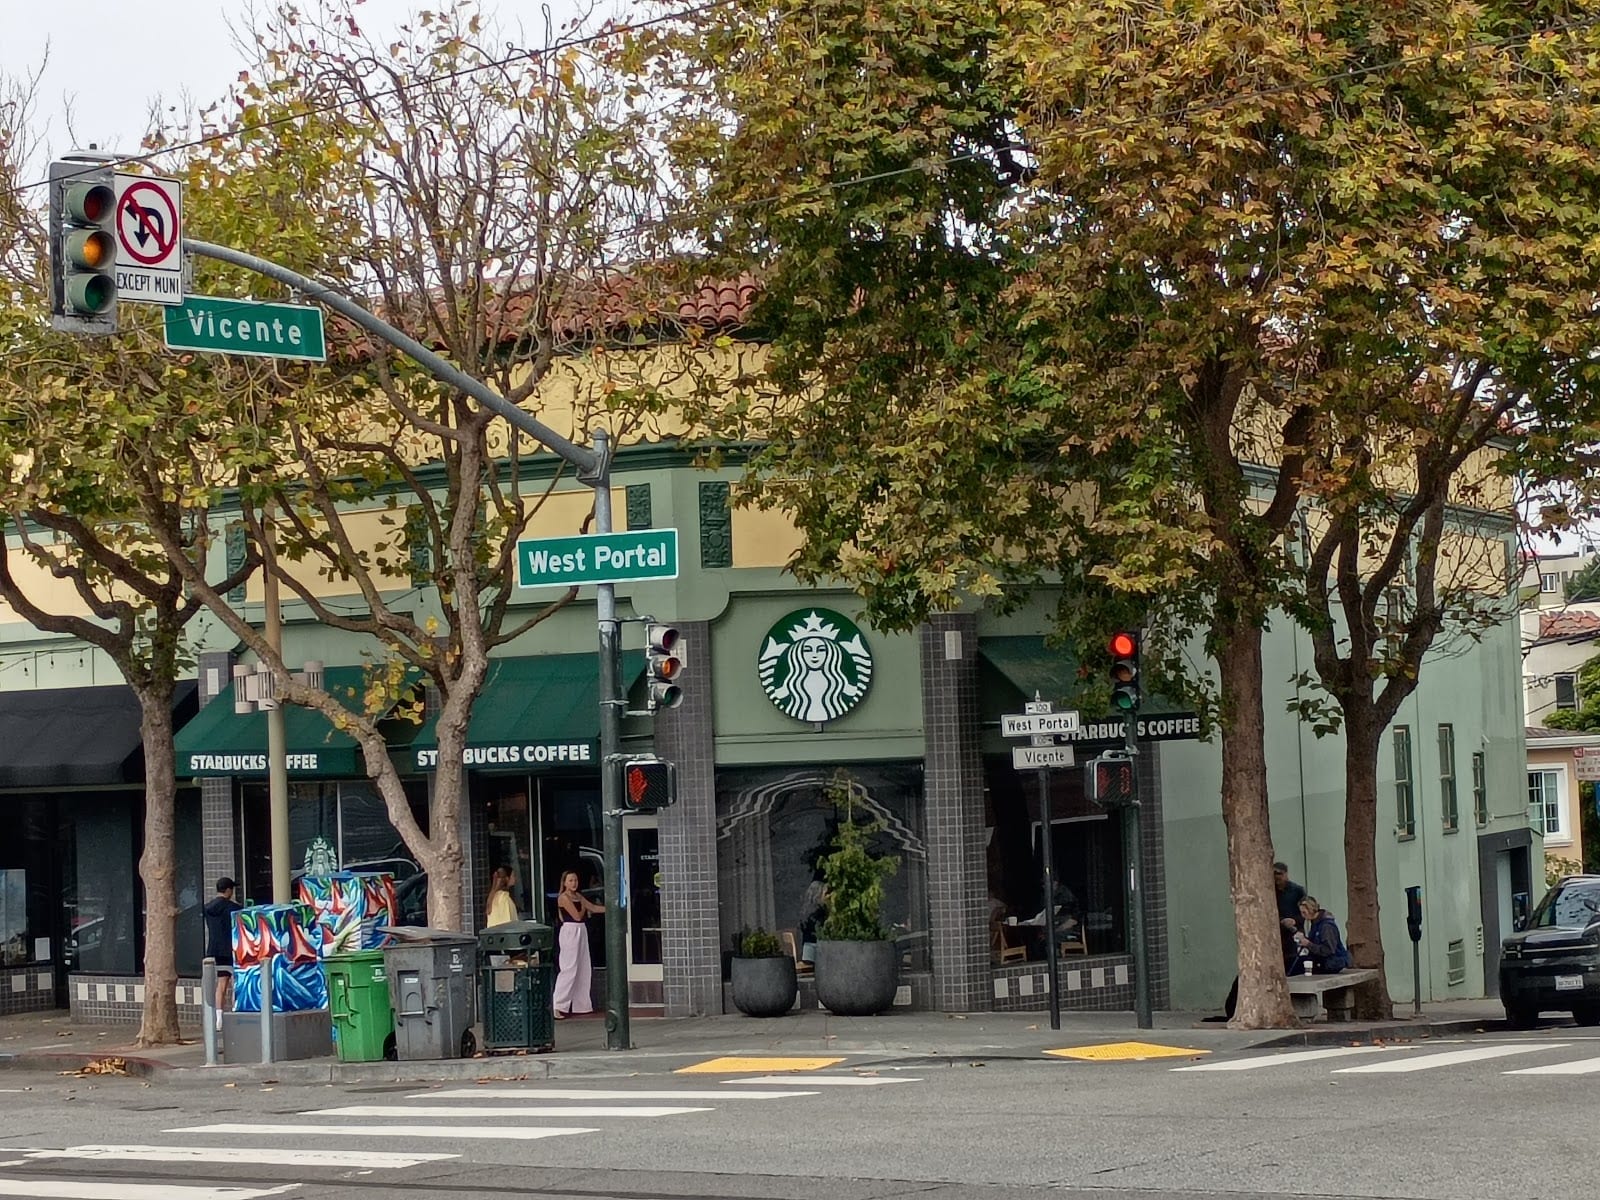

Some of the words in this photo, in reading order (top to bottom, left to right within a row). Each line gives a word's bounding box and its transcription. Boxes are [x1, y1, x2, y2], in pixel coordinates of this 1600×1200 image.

[117, 272, 151, 292] EXCEPT
[155, 276, 179, 294] MUNI
[187, 308, 302, 345] Vicente
[528, 548, 586, 575] West
[595, 542, 667, 570] Portal
[1007, 719, 1032, 732] West
[1039, 717, 1073, 730] Portal
[1149, 718, 1200, 736] COFFEE
[190, 754, 267, 771] STARBUCKS
[268, 754, 318, 770] FFEE
[417, 746, 520, 766] STBUCKS
[523, 744, 591, 762] COFFEE
[1025, 749, 1065, 763] Vicente
